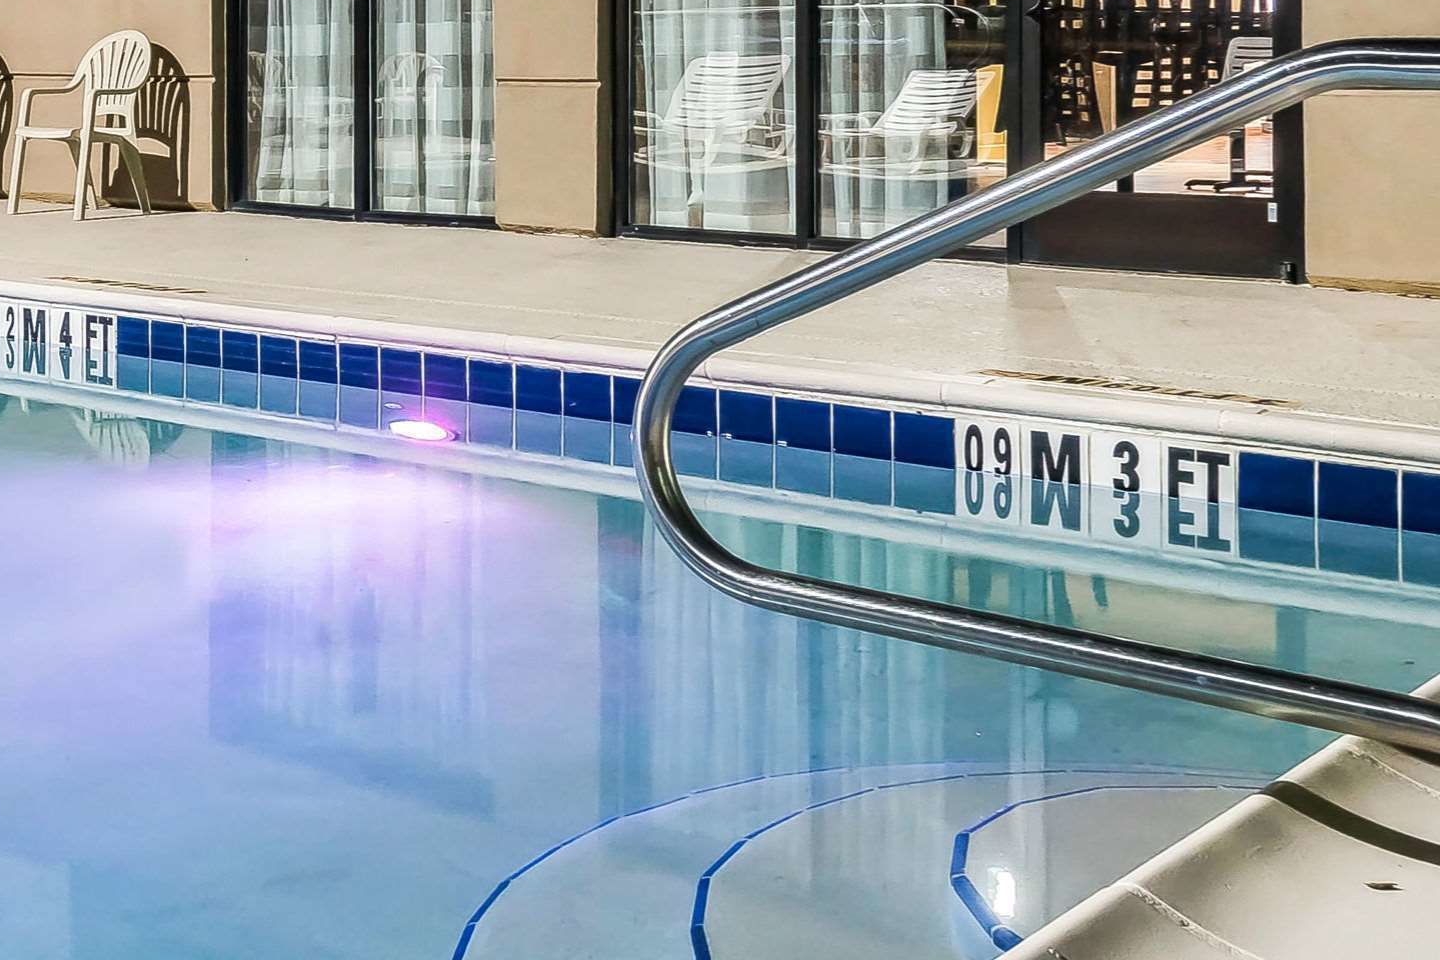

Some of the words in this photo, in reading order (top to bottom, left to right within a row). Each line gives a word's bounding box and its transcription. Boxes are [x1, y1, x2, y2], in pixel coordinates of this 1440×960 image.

[23, 308, 46, 343] M
[60, 311, 72, 347] 4
[86, 314, 113, 352] FT
[1030, 430, 1081, 484] M
[1112, 440, 1140, 492] 3
[1168, 446, 1231, 504] FT
